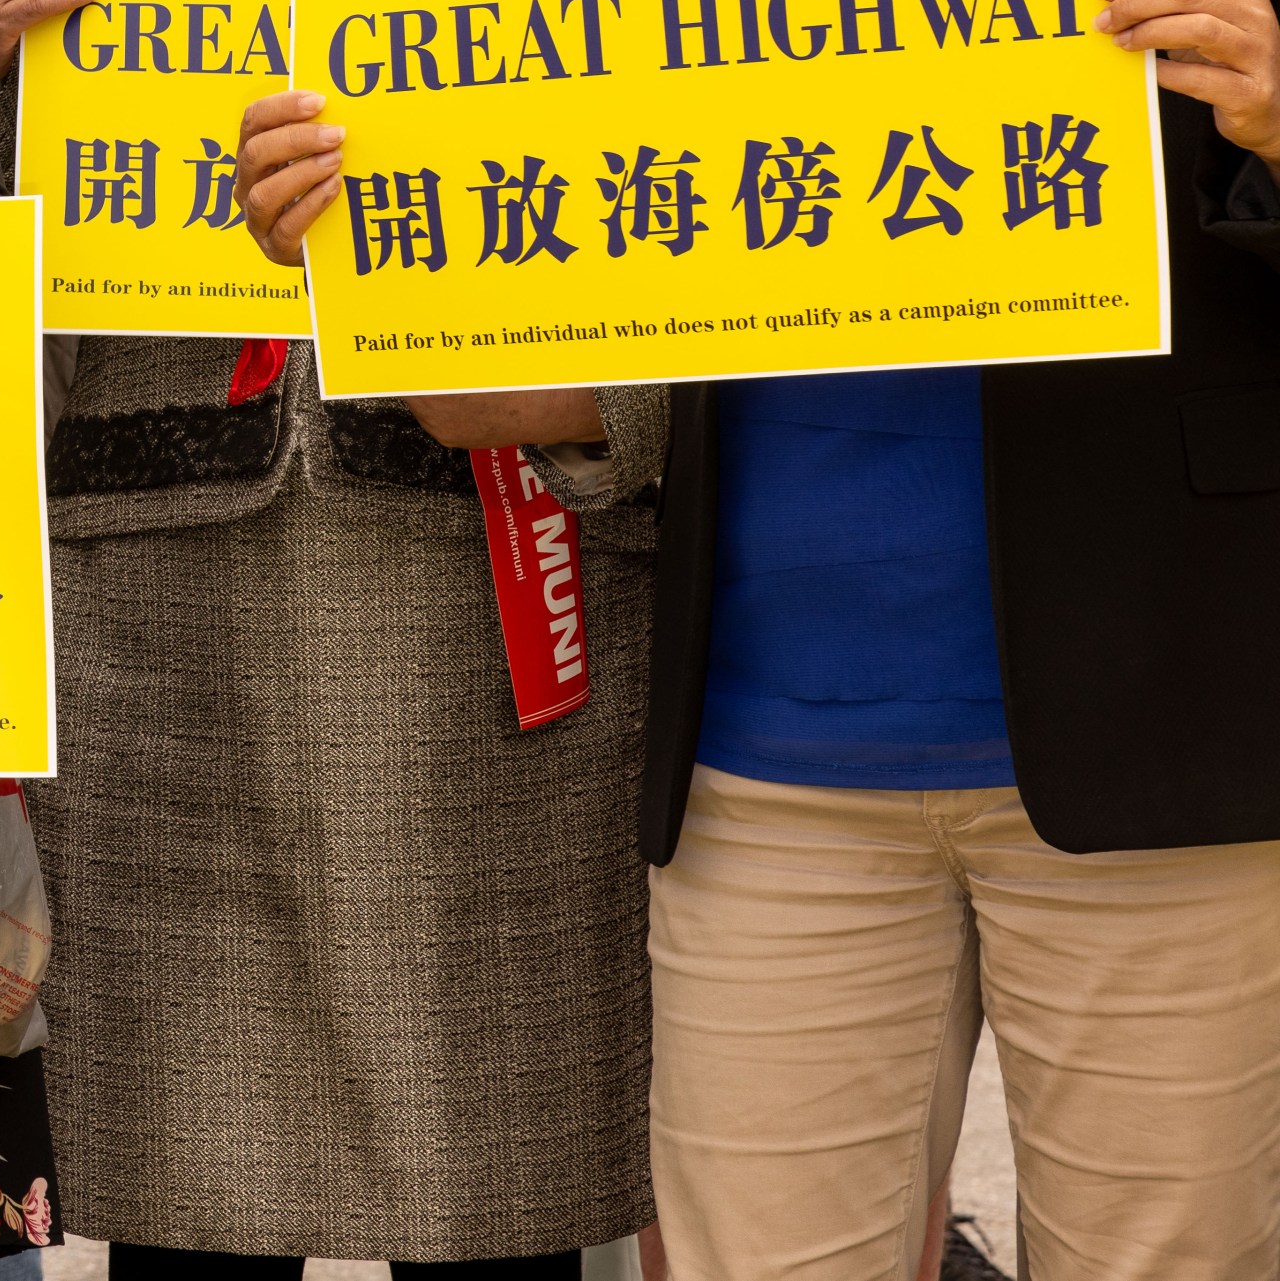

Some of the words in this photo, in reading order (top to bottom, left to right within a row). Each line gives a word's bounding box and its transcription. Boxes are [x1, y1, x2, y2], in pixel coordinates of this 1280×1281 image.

[62, 0, 291, 75] GREA
[343, 114, 1109, 276] 開放海傍公路
[52, 278, 95, 293] Paid
[103, 280, 132, 294] for
[139, 281, 161, 298] by
[168, 285, 191, 295] an
[199, 282, 298, 299] individual
[353, 334, 399, 352] Paid
[404, 333, 434, 349] for
[440, 331, 464, 350] by
[472, 333, 496, 346] an
[502, 322, 608, 344] individual
[614, 320, 657, 337] who
[665, 318, 714, 334] does
[722, 315, 758, 331] not
[766, 308, 841, 332] qualify
[849, 310, 872, 323] as
[880, 309, 891, 321] a
[899, 299, 1000, 321] campaign
[1008, 292, 1129, 313] committee.
[531, 511, 583, 685] MUNI
[0, 991, 21, 1008] OTHER
[8, 984, 27, 1000] LEAST
